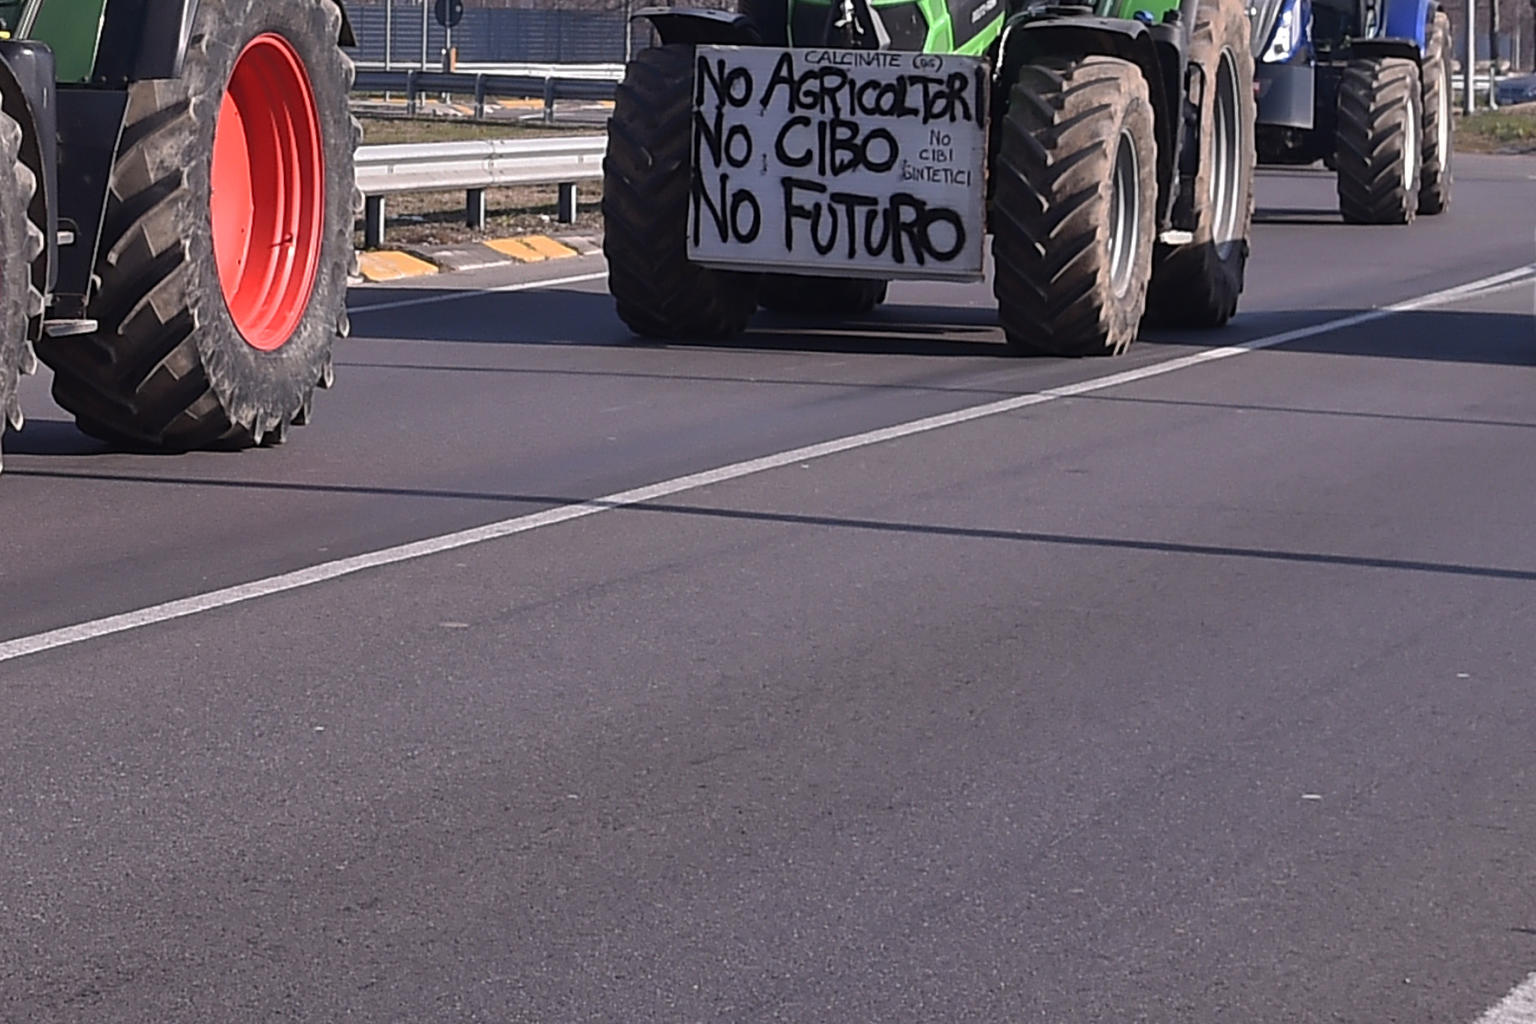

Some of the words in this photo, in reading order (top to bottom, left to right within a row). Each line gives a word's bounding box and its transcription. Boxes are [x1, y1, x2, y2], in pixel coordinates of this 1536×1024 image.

[804, 50, 902, 68] CALCINATE
[695, 56, 753, 108] NO
[759, 52, 986, 129] AGRICOLTORI
[693, 109, 752, 168] NO
[775, 116, 899, 176] CIBO
[919, 148, 953, 162] CIBI
[902, 164, 972, 187] SINTETICI
[692, 173, 761, 247] NO
[781, 176, 966, 266] FUTURO
